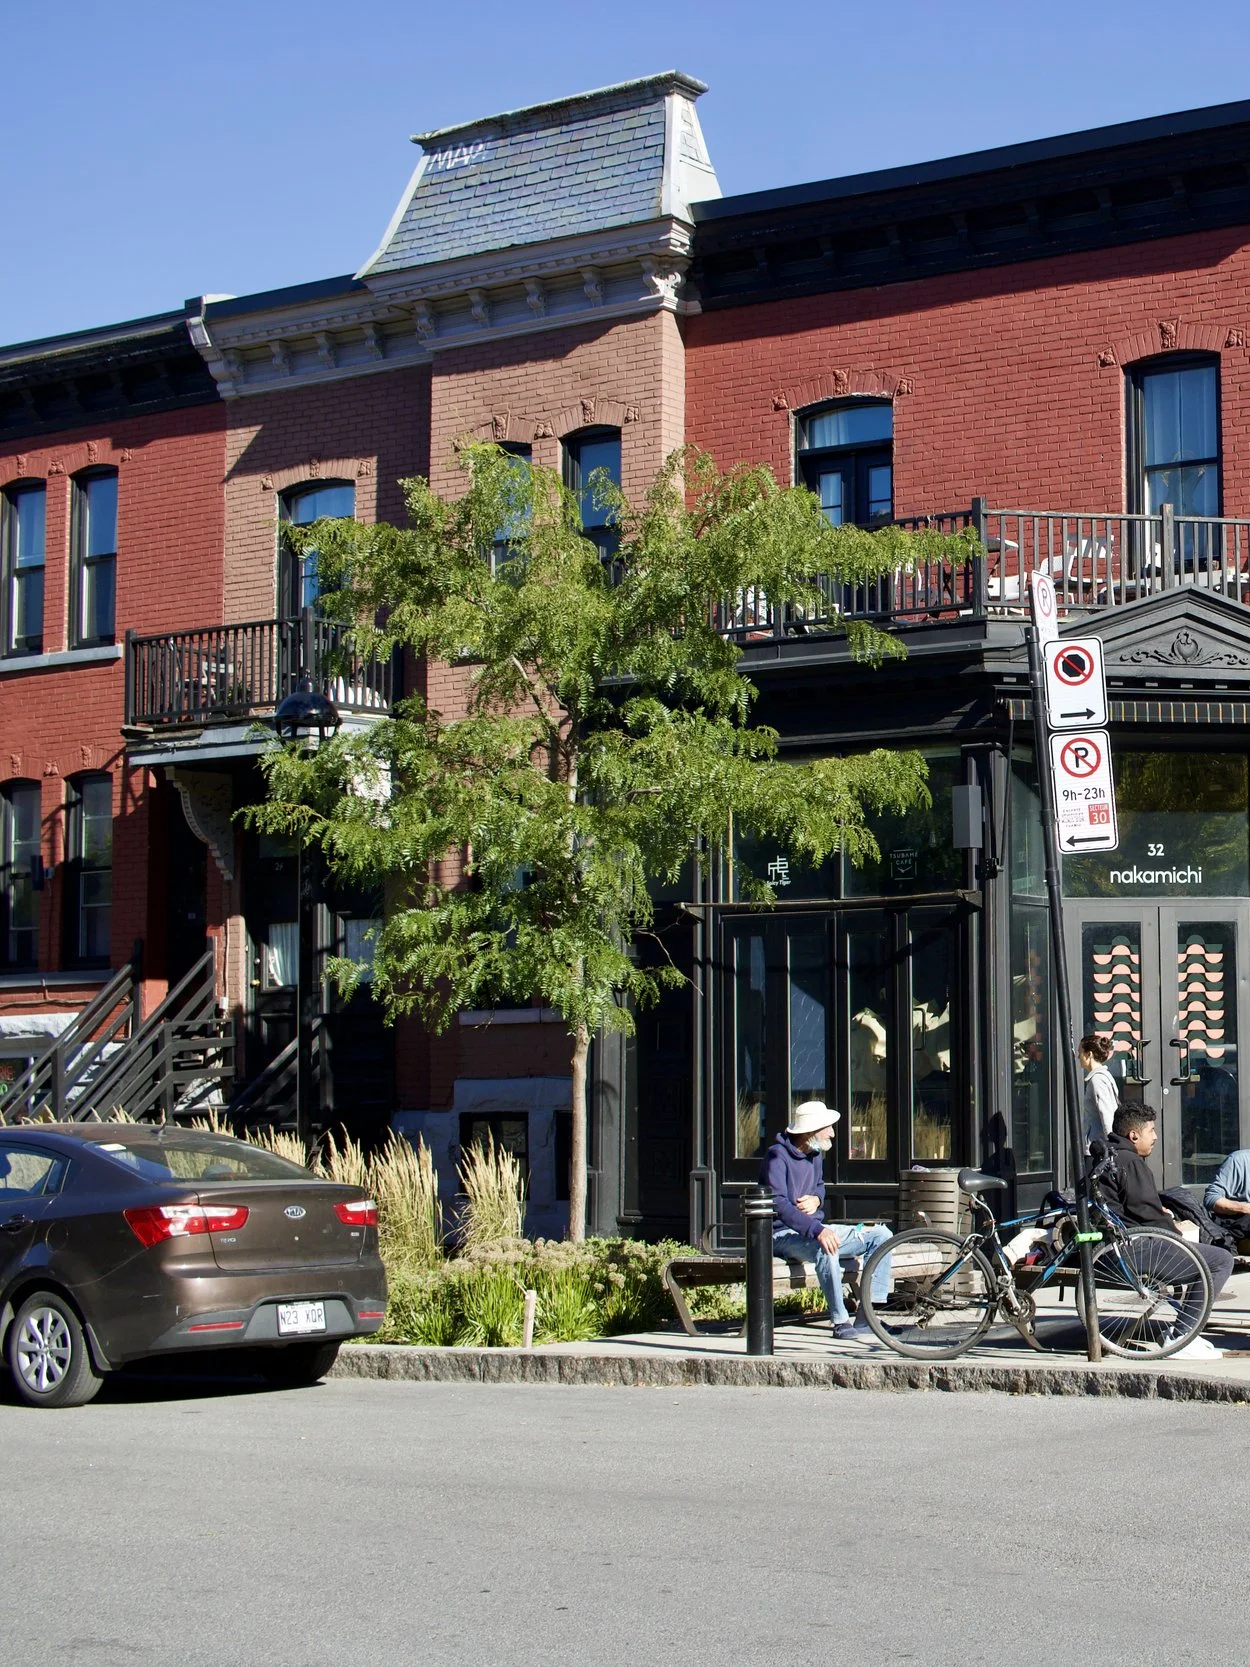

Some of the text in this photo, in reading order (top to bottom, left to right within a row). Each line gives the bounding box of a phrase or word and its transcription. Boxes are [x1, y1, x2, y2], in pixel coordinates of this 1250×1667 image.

[1062, 787, 1106, 801] 9h-23h
[1091, 811, 1108, 824] 30
[1147, 843, 1165, 856] 32
[1110, 865, 1202, 884] nakamichi
